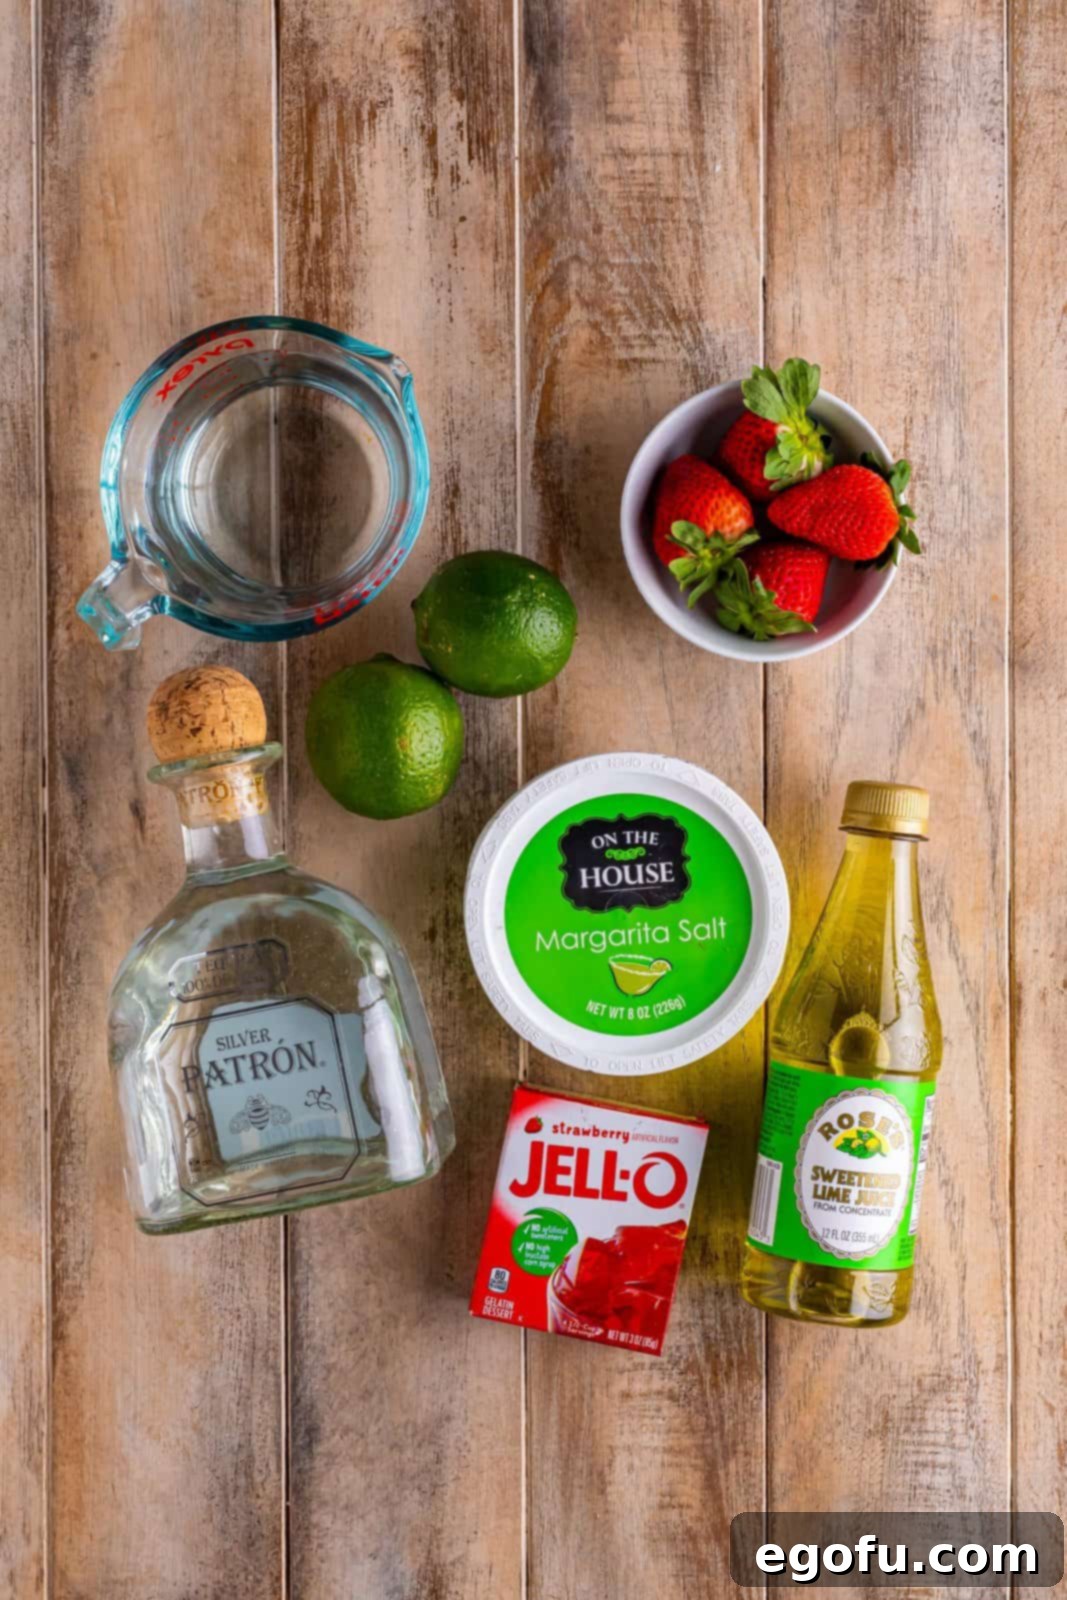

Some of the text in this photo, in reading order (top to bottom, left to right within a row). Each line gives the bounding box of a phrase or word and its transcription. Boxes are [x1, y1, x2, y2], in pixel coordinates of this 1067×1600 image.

[591, 830, 660, 849] ON THE
[579, 861, 675, 889] HOUSE
[535, 916, 727, 953] Margarita Salt
[586, 994, 686, 1020] NET WT 8 OZ (226g)
[216, 1028, 272, 1051] SILVER
[181, 1038, 318, 1093] PATRÓN
[552, 1121, 630, 1144] strawberry
[508, 1140, 688, 1209] JELL-O
[813, 1184, 896, 1208] LIME JUICE
[813, 1201, 892, 1217] FROM CONCENTRATE
[831, 1228, 840, 1240] FL
[841, 1230, 851, 1242] OZ
[482, 1306, 514, 1320] DESSERT
[484, 1296, 514, 1310] GELATIN
